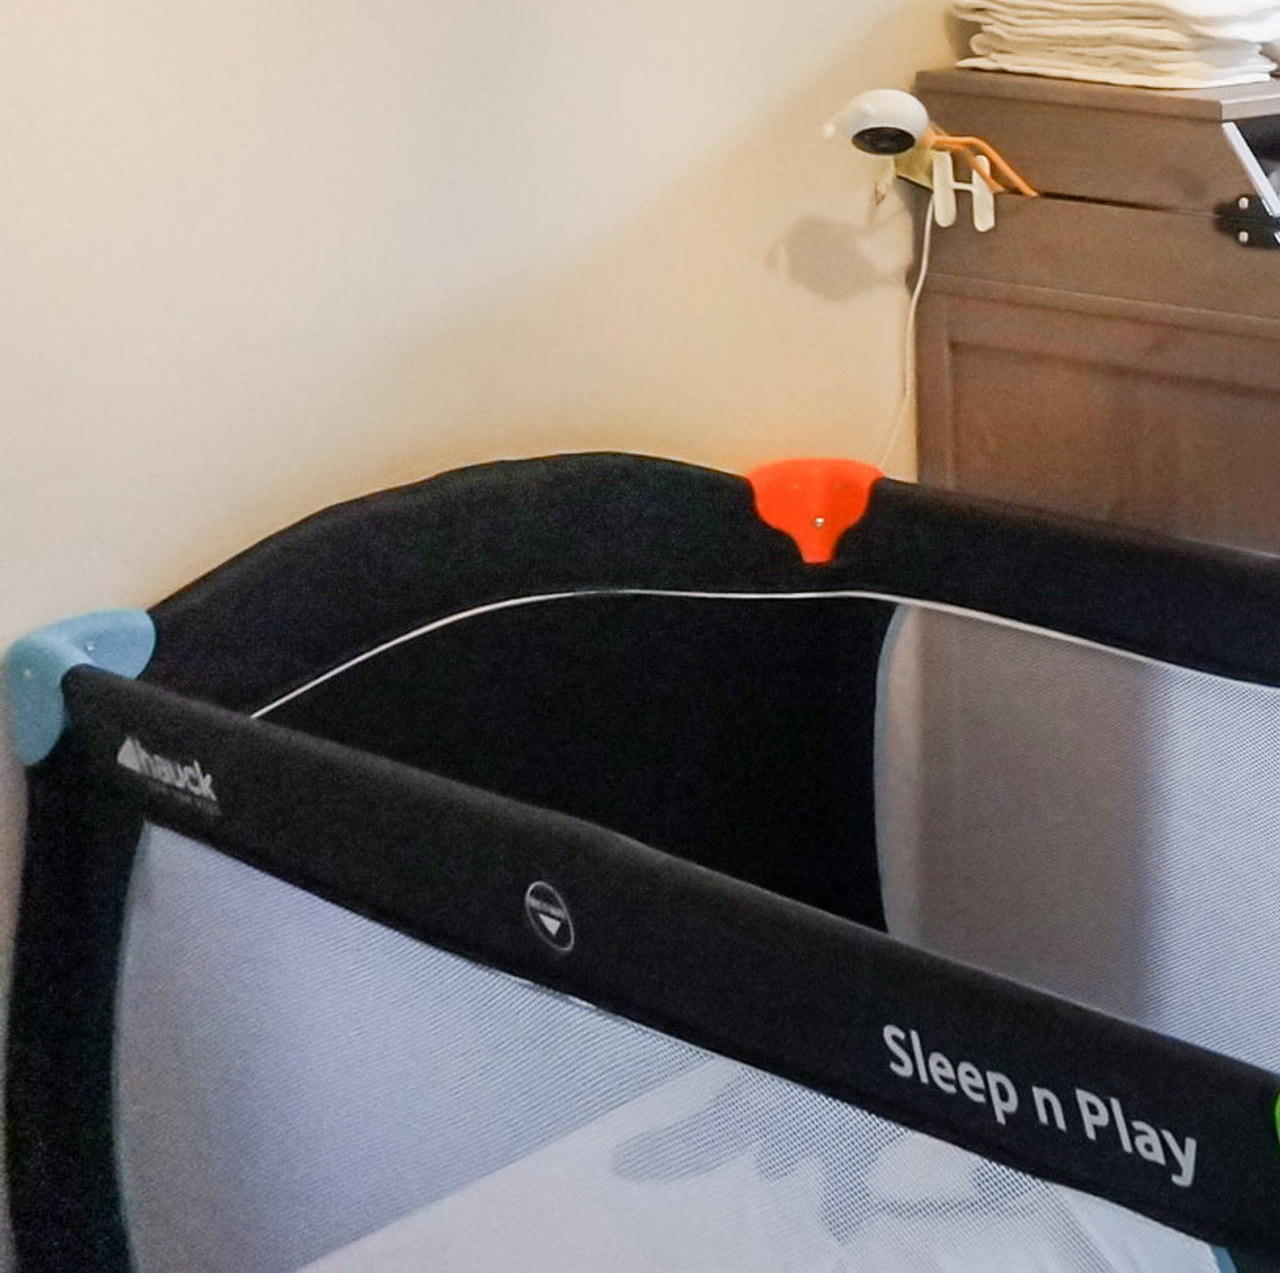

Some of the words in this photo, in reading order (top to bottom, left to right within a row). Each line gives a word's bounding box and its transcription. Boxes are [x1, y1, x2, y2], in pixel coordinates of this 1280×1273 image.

[135, 739, 217, 801] hauck
[882, 1024, 1018, 1125] Sleep
[1031, 1086, 1067, 1131] n
[1076, 1088, 1197, 1188] Play
